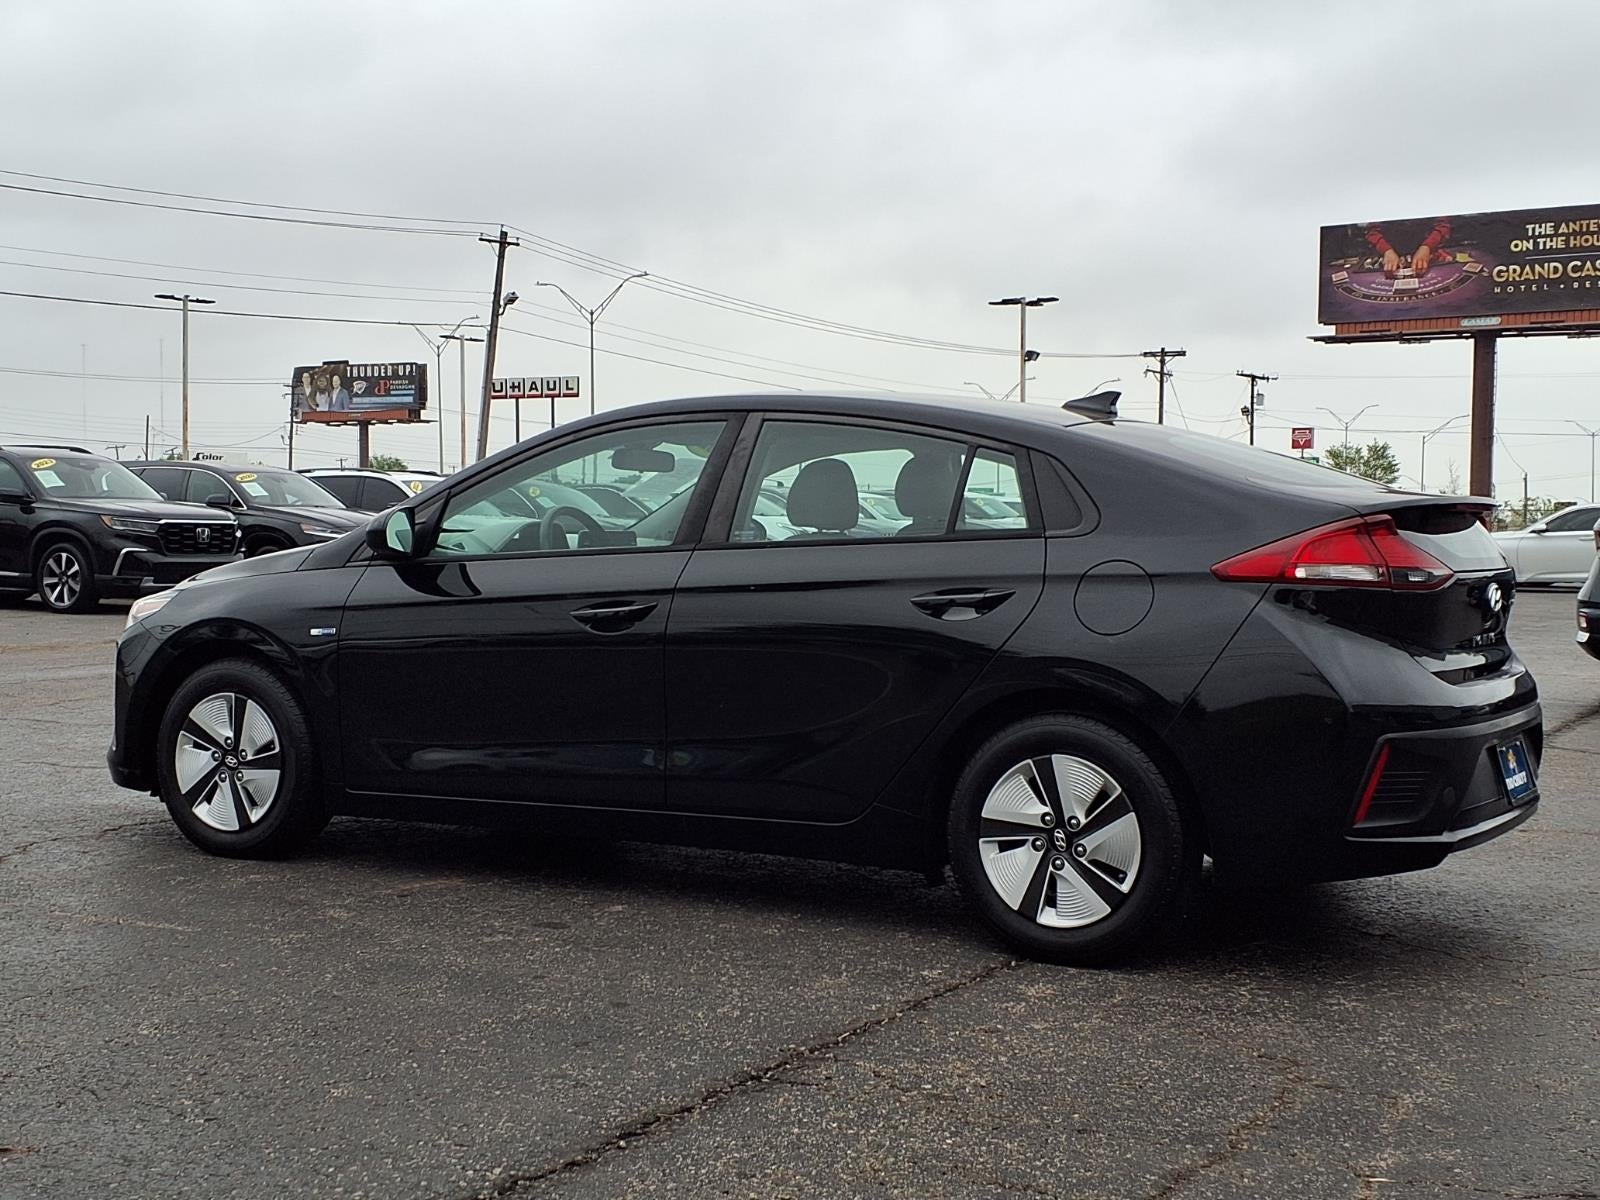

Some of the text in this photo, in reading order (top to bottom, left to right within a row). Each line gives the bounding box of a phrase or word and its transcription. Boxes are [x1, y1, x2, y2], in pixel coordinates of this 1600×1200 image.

[1526, 222, 1555, 236] THE
[1510, 239, 1533, 252] ON
[1537, 236, 1566, 250] THE
[1492, 261, 1563, 282] GRAND
[1494, 283, 1549, 293] HOTEL
[346, 364, 416, 377] THUNDER UP!
